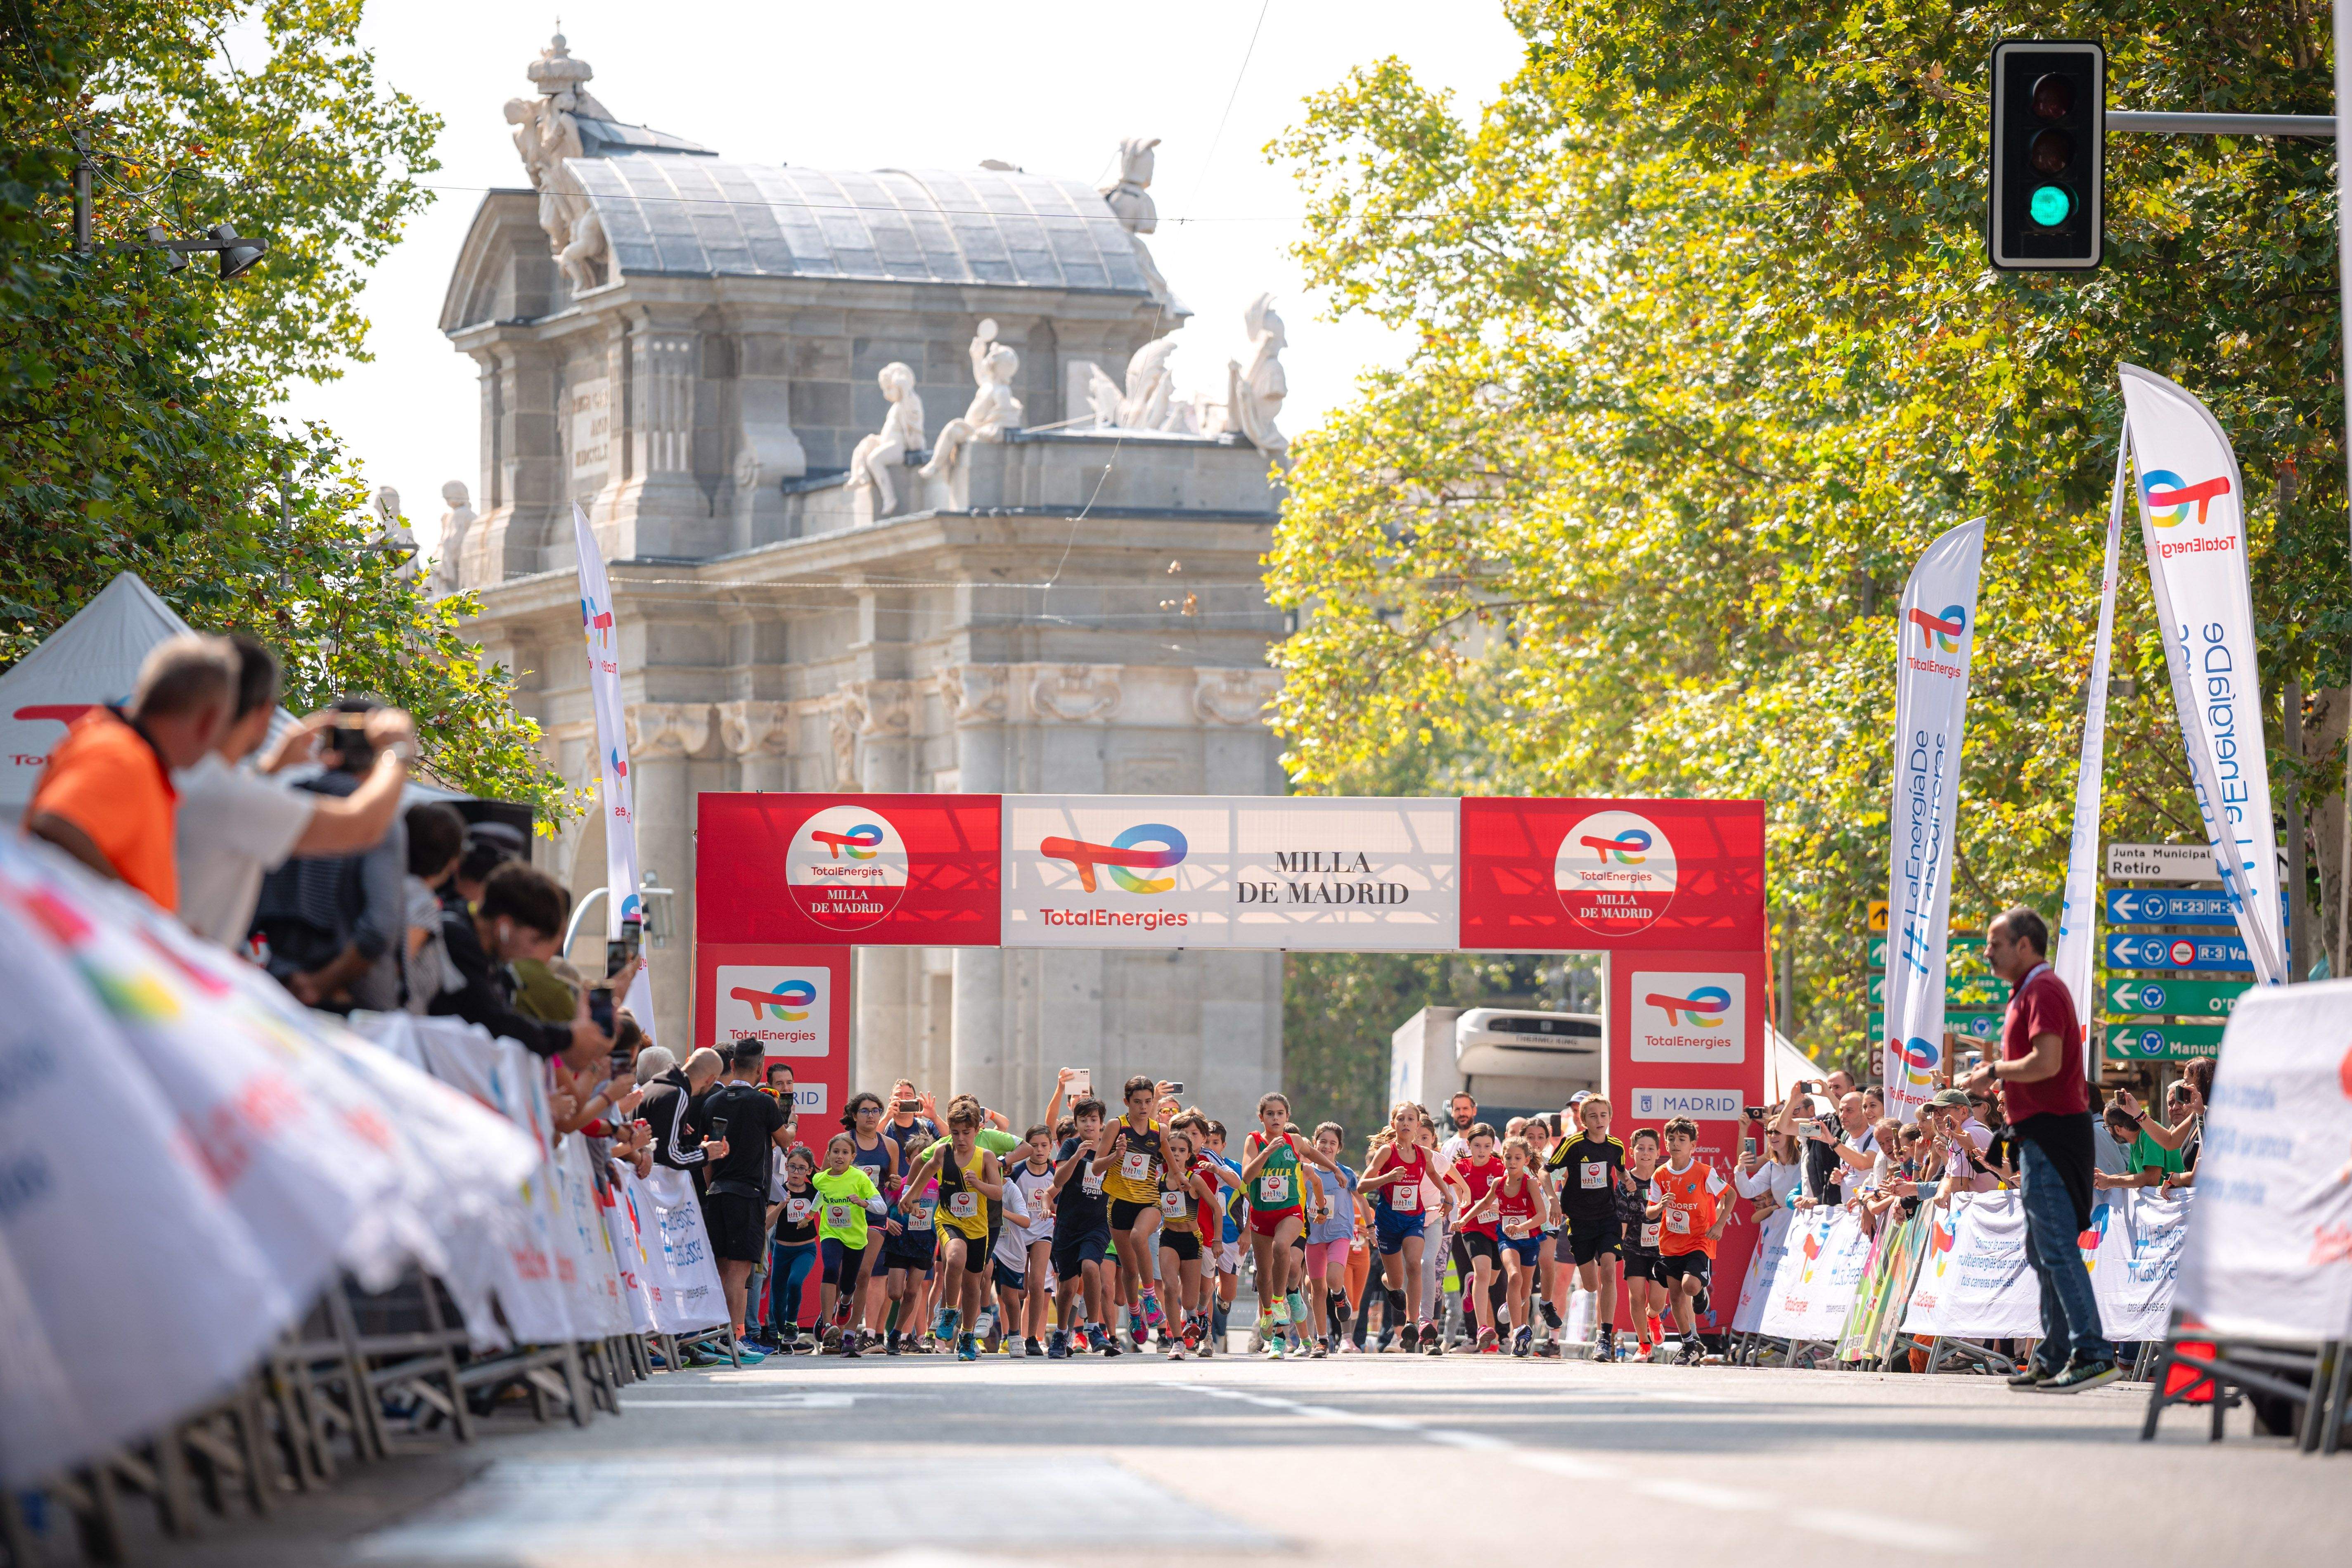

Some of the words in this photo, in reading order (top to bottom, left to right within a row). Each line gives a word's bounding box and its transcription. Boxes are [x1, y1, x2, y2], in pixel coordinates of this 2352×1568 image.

[2113, 848, 2145, 857] Junta
[2153, 848, 2210, 860] Municipal
[1274, 851, 1373, 873] MILLA
[2113, 861, 2160, 874] Retiro
[811, 866, 883, 878] TotalEnergies
[1580, 872, 1652, 883] TotalEnergies
[827, 890, 868, 900] MILLA
[1236, 882, 1278, 903] DE
[1287, 883, 1409, 904] MADRID
[1596, 895, 1637, 905] MILLA
[812, 903, 829, 913] DE
[832, 903, 883, 913] MADRID
[1580, 907, 1597, 918] DE
[1601, 908, 1652, 919] MADRID
[2172, 902, 2203, 913] M-23
[1040, 908, 1188, 931] TotalEnergies
[2201, 947, 2223, 959] R-3
[730, 1029, 816, 1043] TotalEnergies
[1645, 1035, 1731, 1049] TotalEnergies
[1664, 1097, 1735, 1111] MADRID
[1961, 1274, 1970, 1286] tus
[1971, 1277, 1990, 1288] carreras
